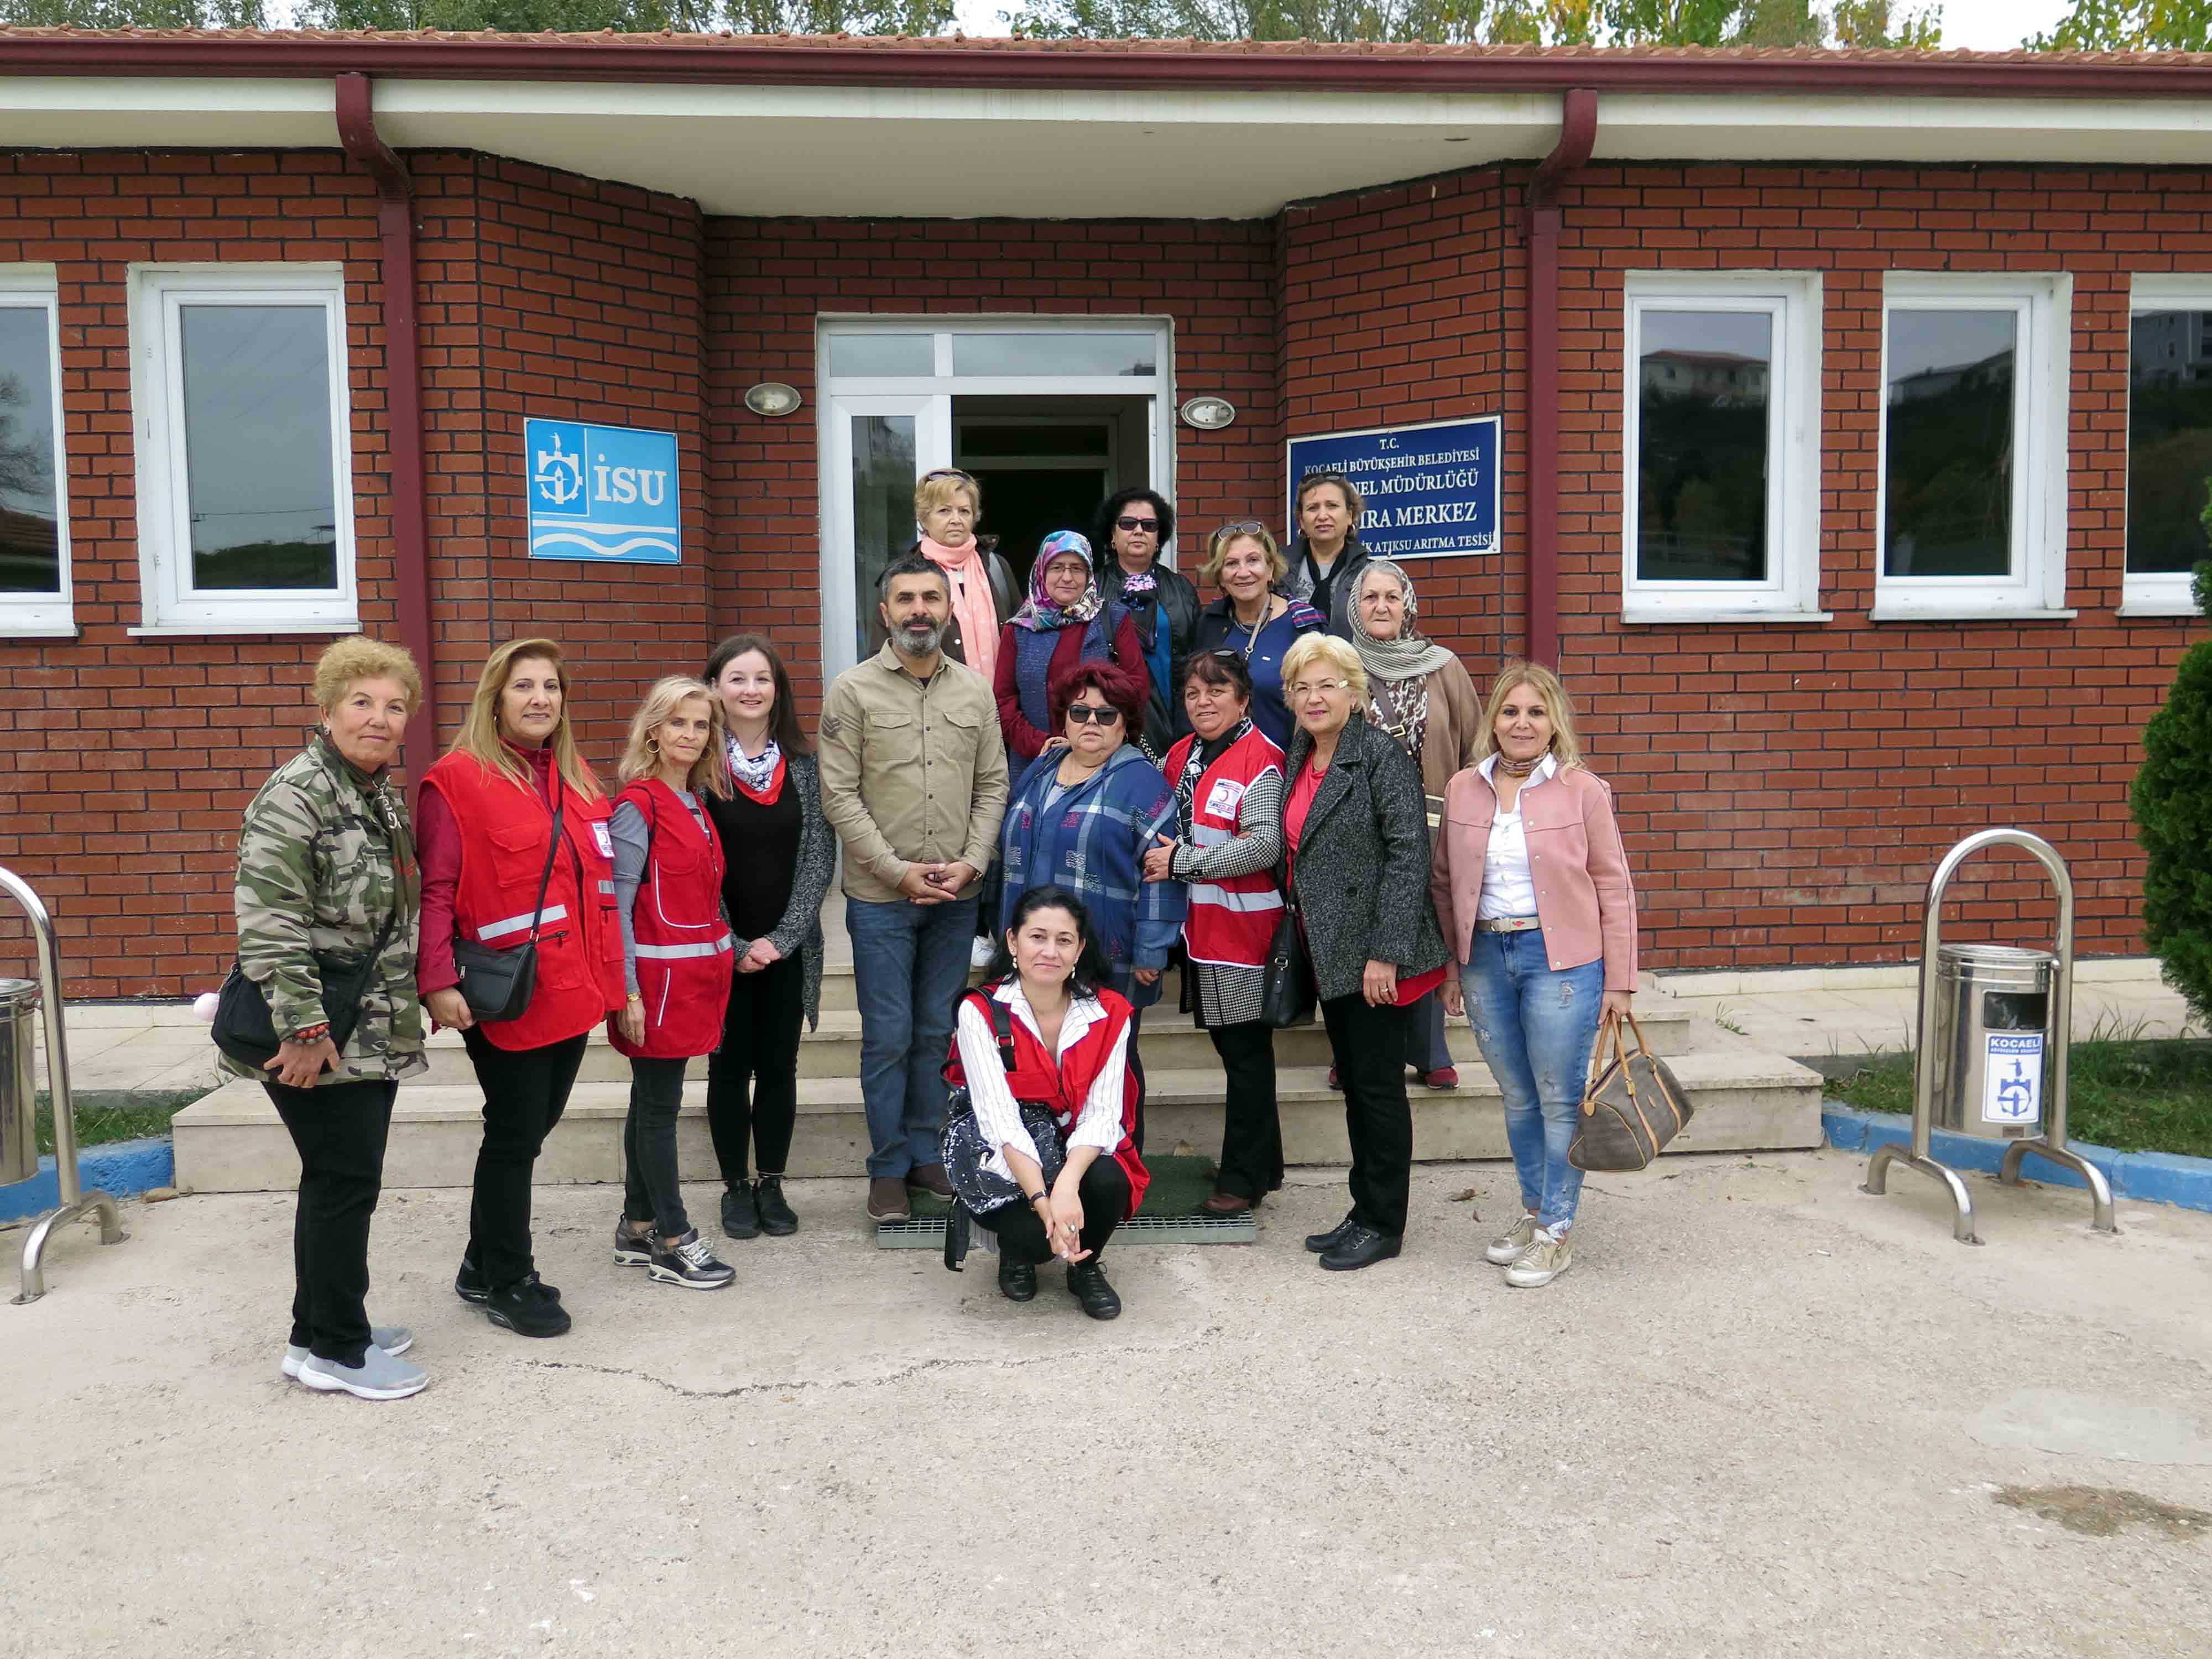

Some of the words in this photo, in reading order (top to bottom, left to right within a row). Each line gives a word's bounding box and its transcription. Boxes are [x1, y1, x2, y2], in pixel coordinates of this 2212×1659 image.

[1379, 438, 1399, 450] T.C.
[1305, 460, 1347, 475] KOCAELİ
[1349, 453, 1416, 473] BÜYÜKŞEHİR
[1418, 446, 1479, 466] BELEDİYESİ
[1349, 481, 1378, 496] NEL
[1380, 468, 1479, 494] MÜDÜRLÜĞÜ
[1395, 502, 1477, 526] MERKEZ
[1413, 536, 1455, 550] ARITMA
[1457, 531, 1491, 547] TESİSİ
